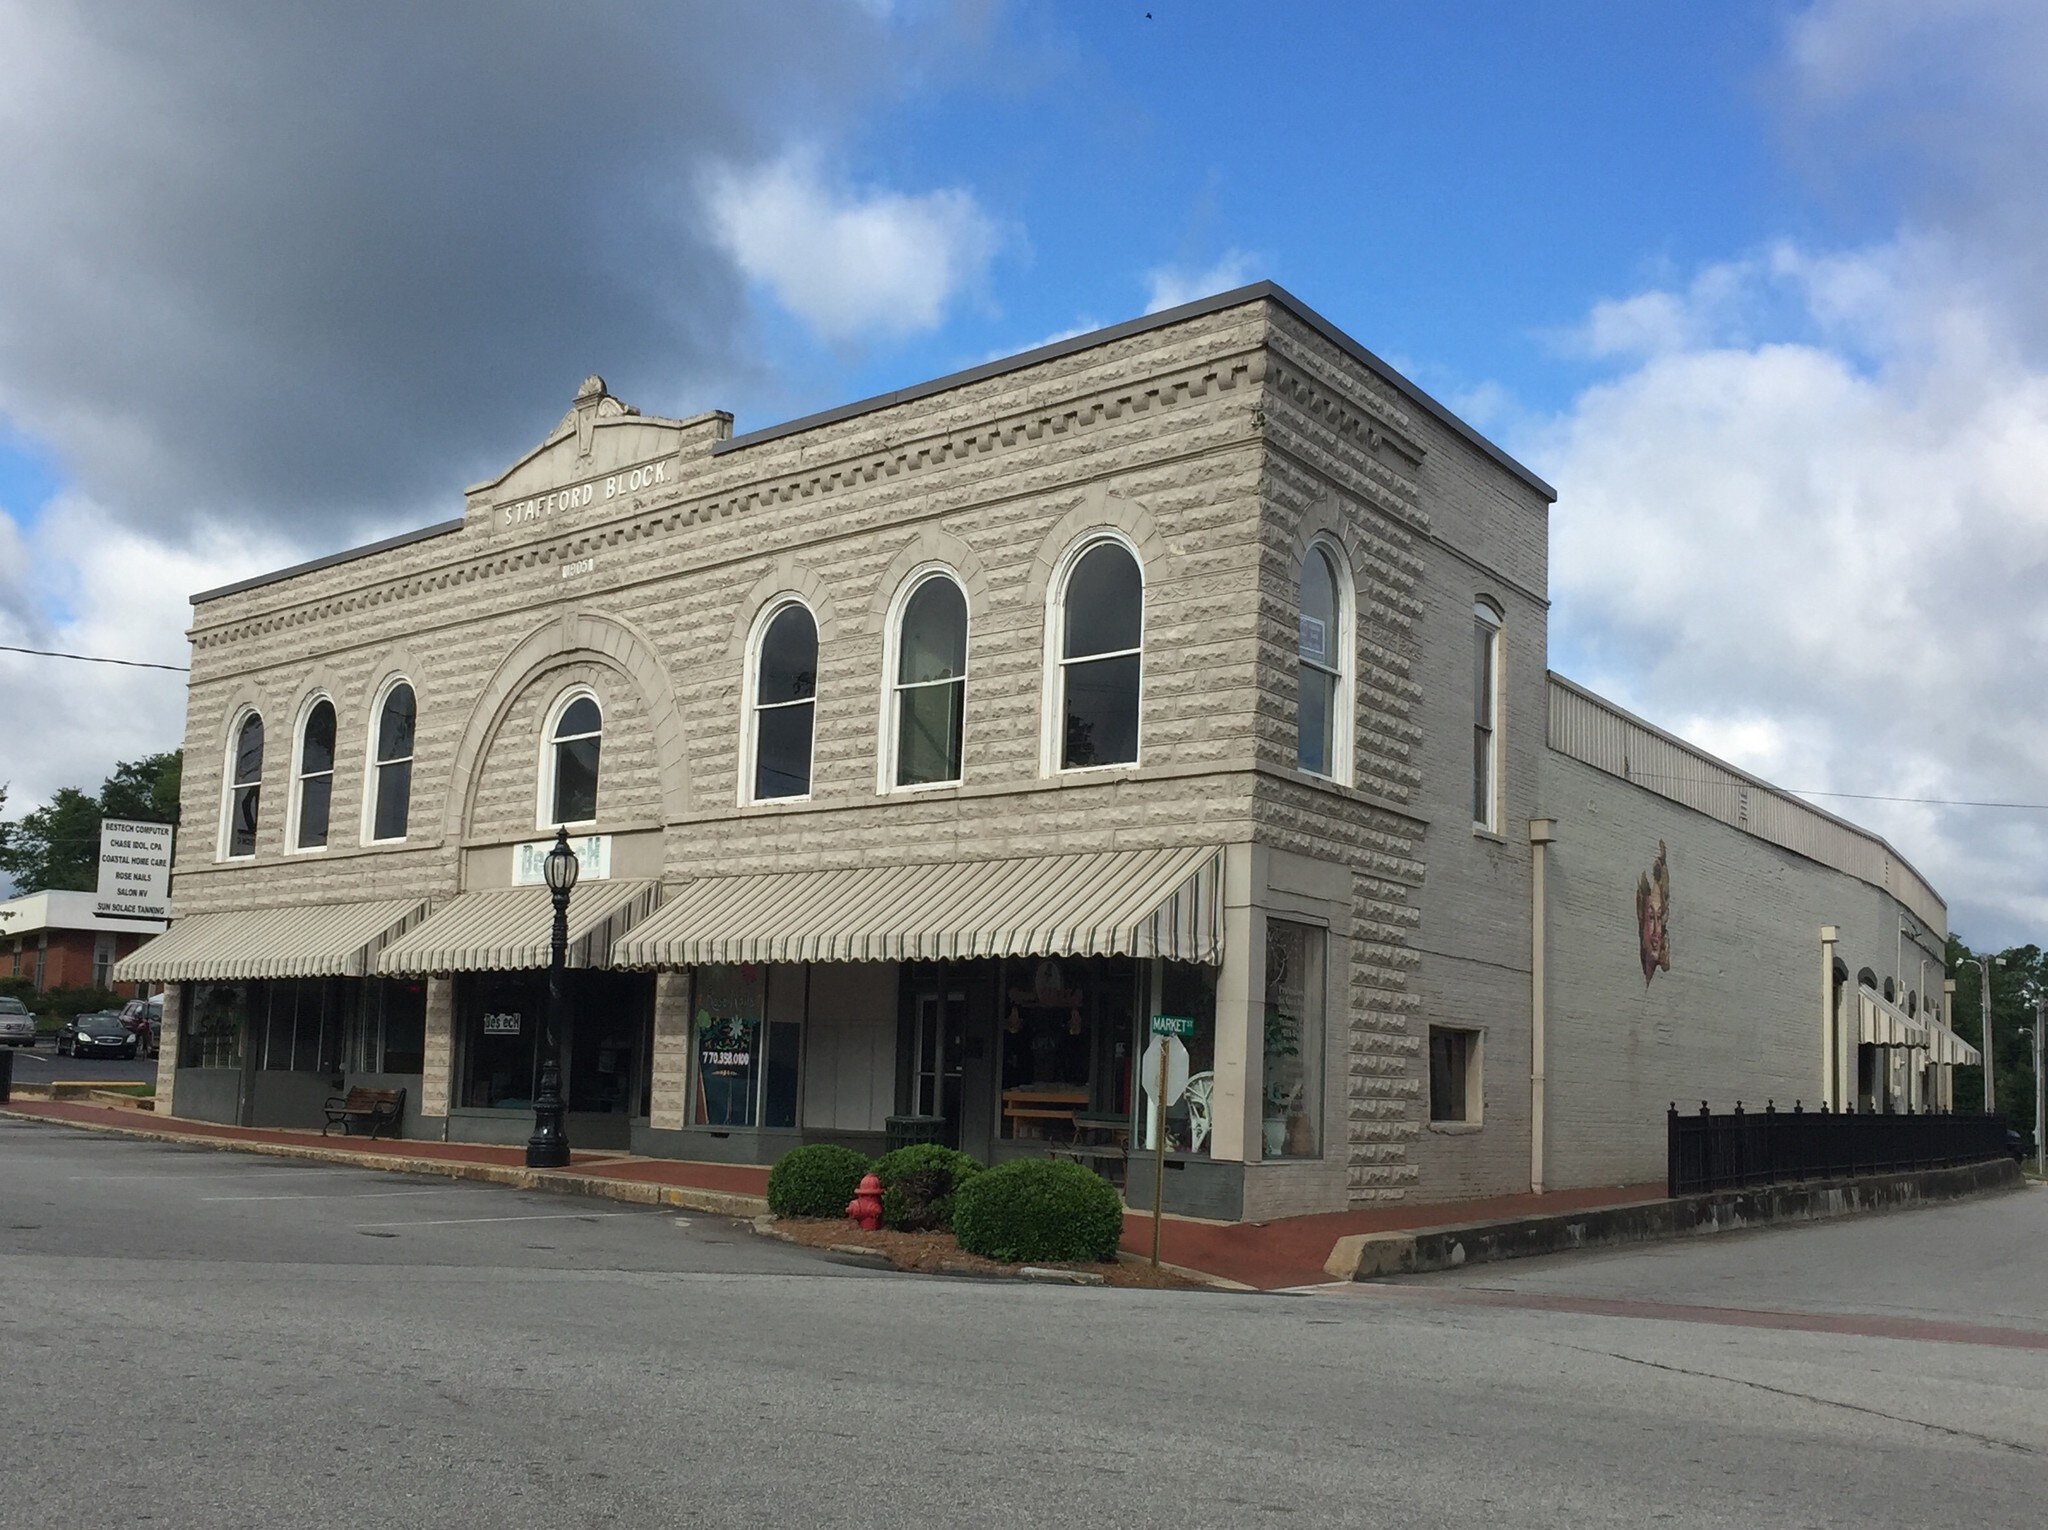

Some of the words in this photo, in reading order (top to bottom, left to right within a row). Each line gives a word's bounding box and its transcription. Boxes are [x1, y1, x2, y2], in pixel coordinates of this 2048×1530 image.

[505, 483, 593, 526] STAFFORD
[105, 822, 134, 833] BESTECH
[135, 825, 170, 836] COMPUTER
[110, 839, 132, 849] CHASE
[150, 842, 162, 851] CPA
[101, 854, 130, 864] COASTAL
[131, 857, 150, 866] HOME
[150, 858, 168, 867] CARE
[115, 871, 132, 881] ROSE
[133, 873, 152, 882] NAILS
[116, 887, 138, 897] SALON
[138, 889, 149, 898] NV
[96, 902, 112, 911] SUN
[112, 903, 136, 913] SOLACE
[137, 905, 165, 915] TANNING
[1153, 1016, 1187, 1033] MARKET
